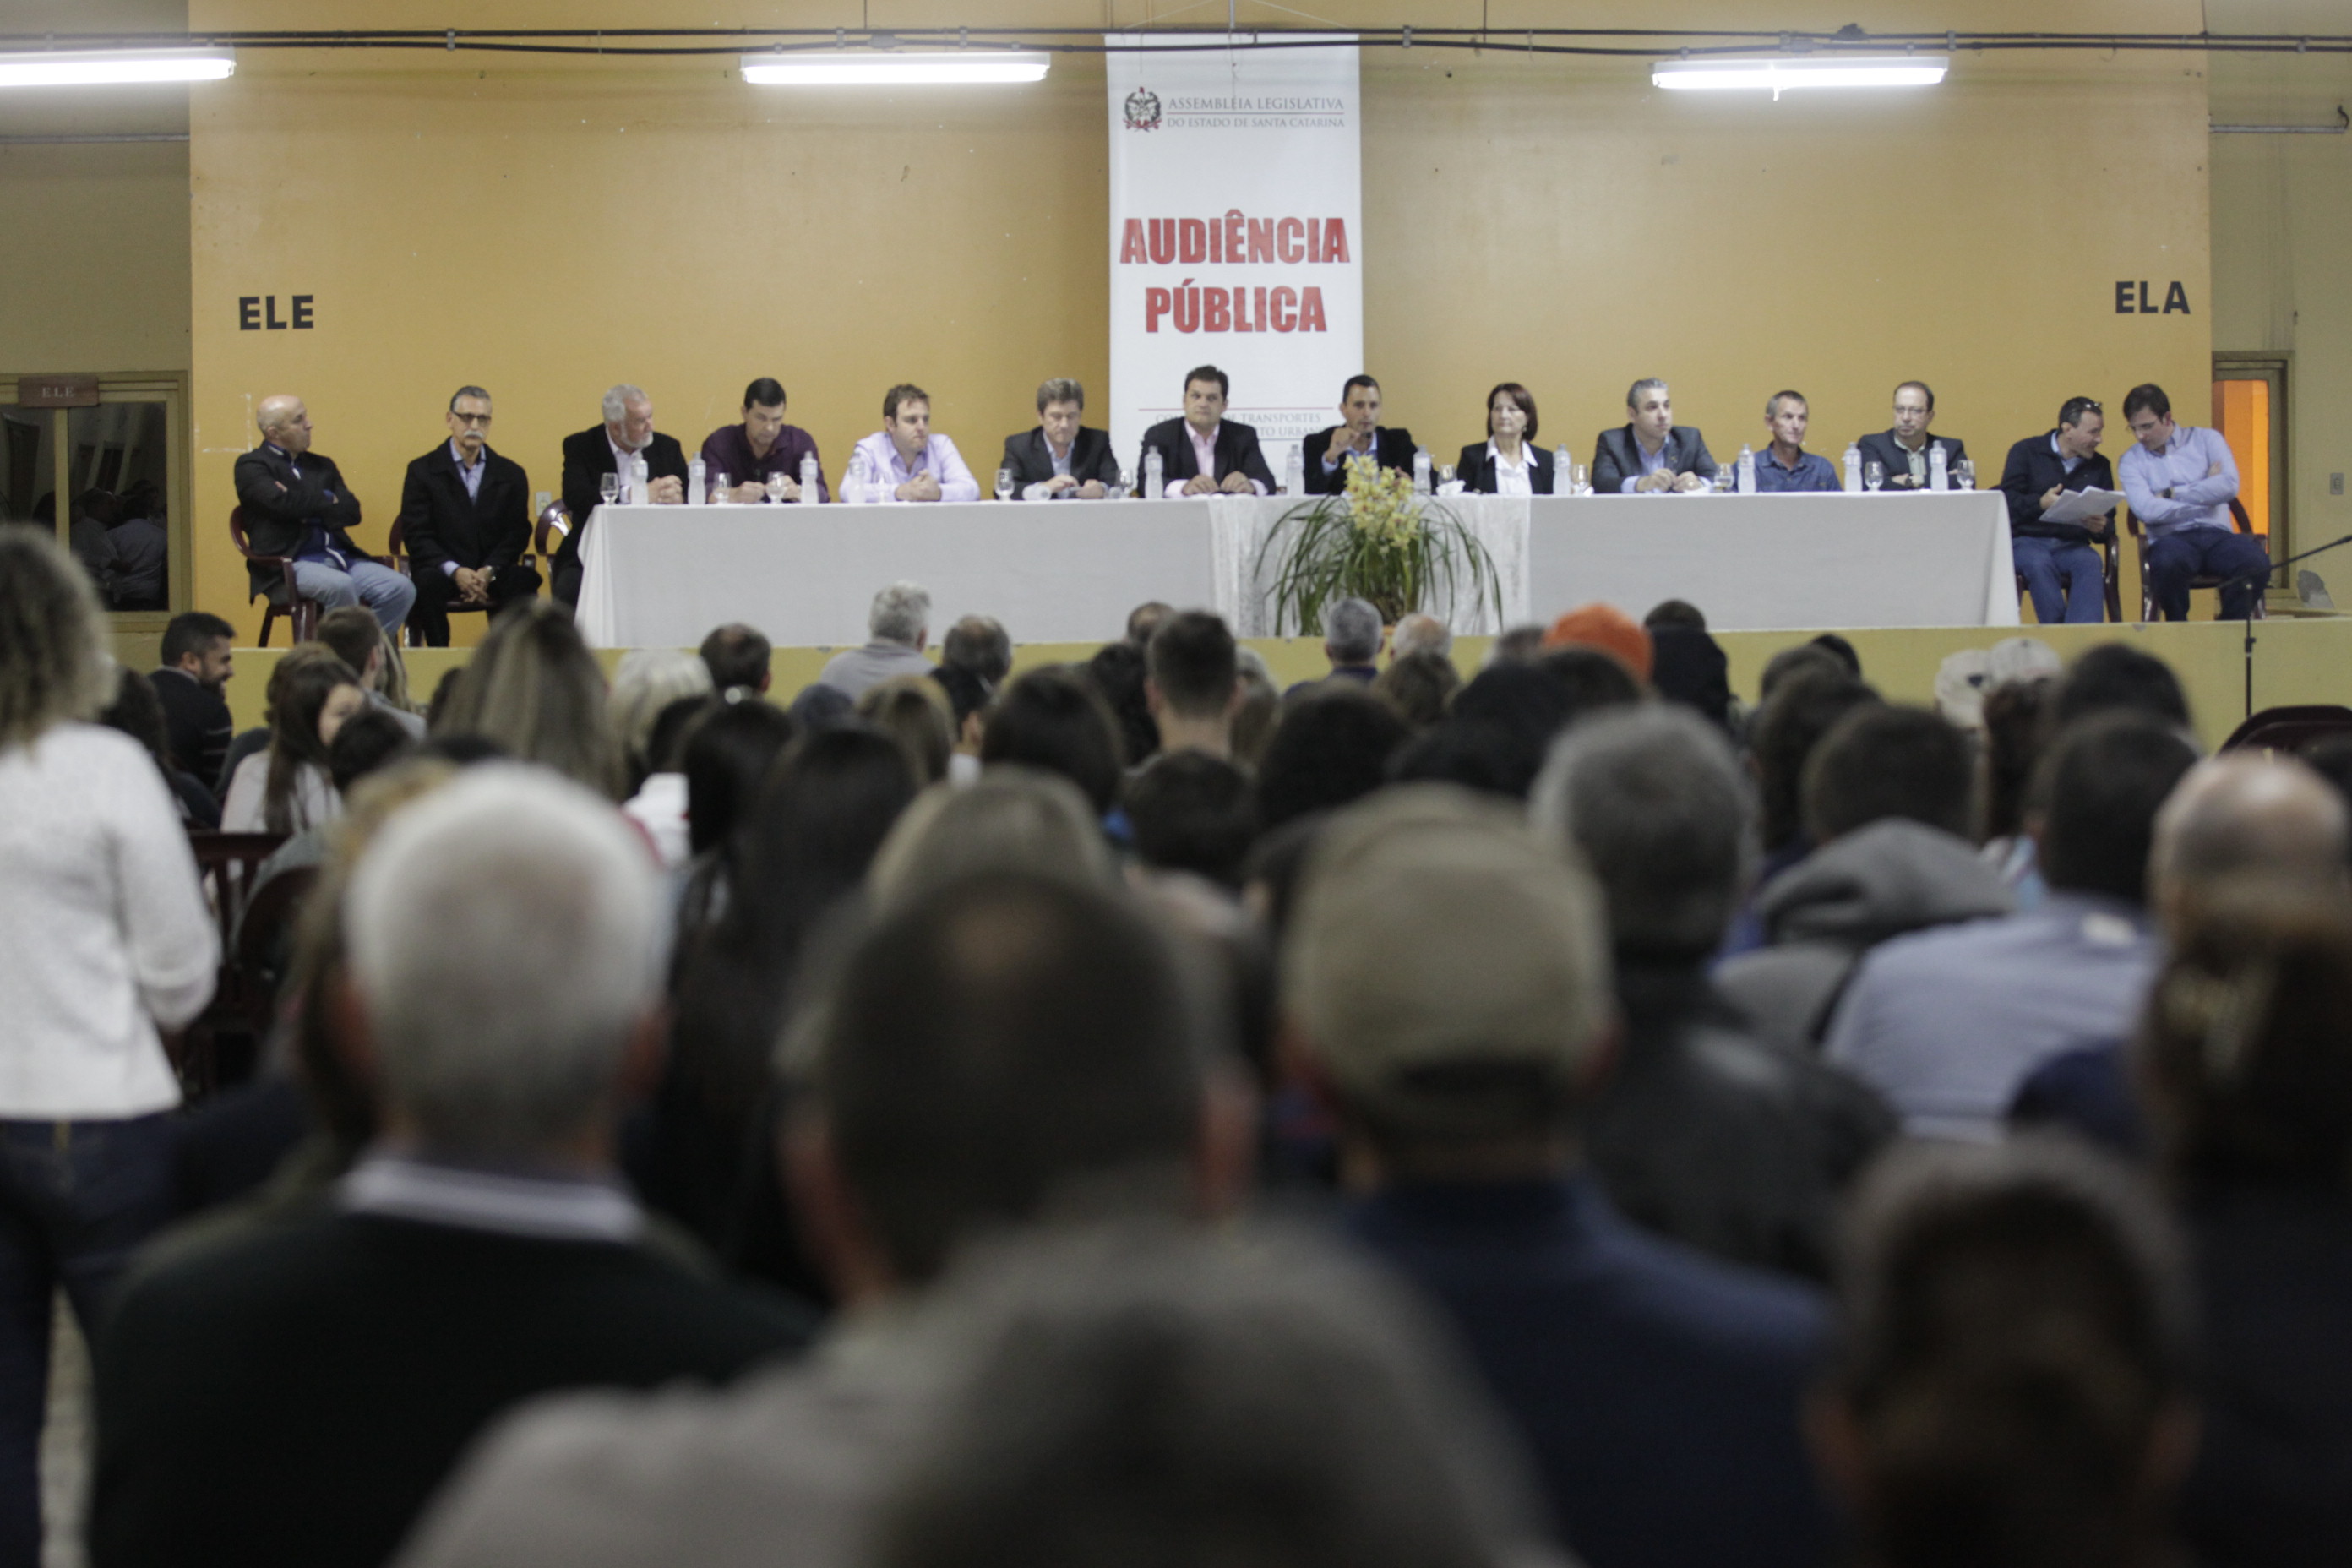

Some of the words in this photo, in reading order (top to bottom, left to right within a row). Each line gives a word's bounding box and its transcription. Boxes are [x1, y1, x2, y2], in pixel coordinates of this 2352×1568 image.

[1257, 97, 1344, 110] LEGISLATIVA
[1167, 117, 1185, 128] DO
[1188, 117, 1231, 128] ESTADO
[1234, 117, 1249, 128] DE
[1252, 117, 1287, 128] SANTA
[1289, 117, 1345, 128] CATARINA
[1119, 209, 1351, 264] AUDIÊNCIA
[1146, 278, 1327, 333] PÚBLICA
[2115, 280, 2191, 314] ELA
[239, 295, 313, 330] ELE
[42, 386, 75, 398] ELE
[1241, 412, 1321, 423] TRANSPORTES
